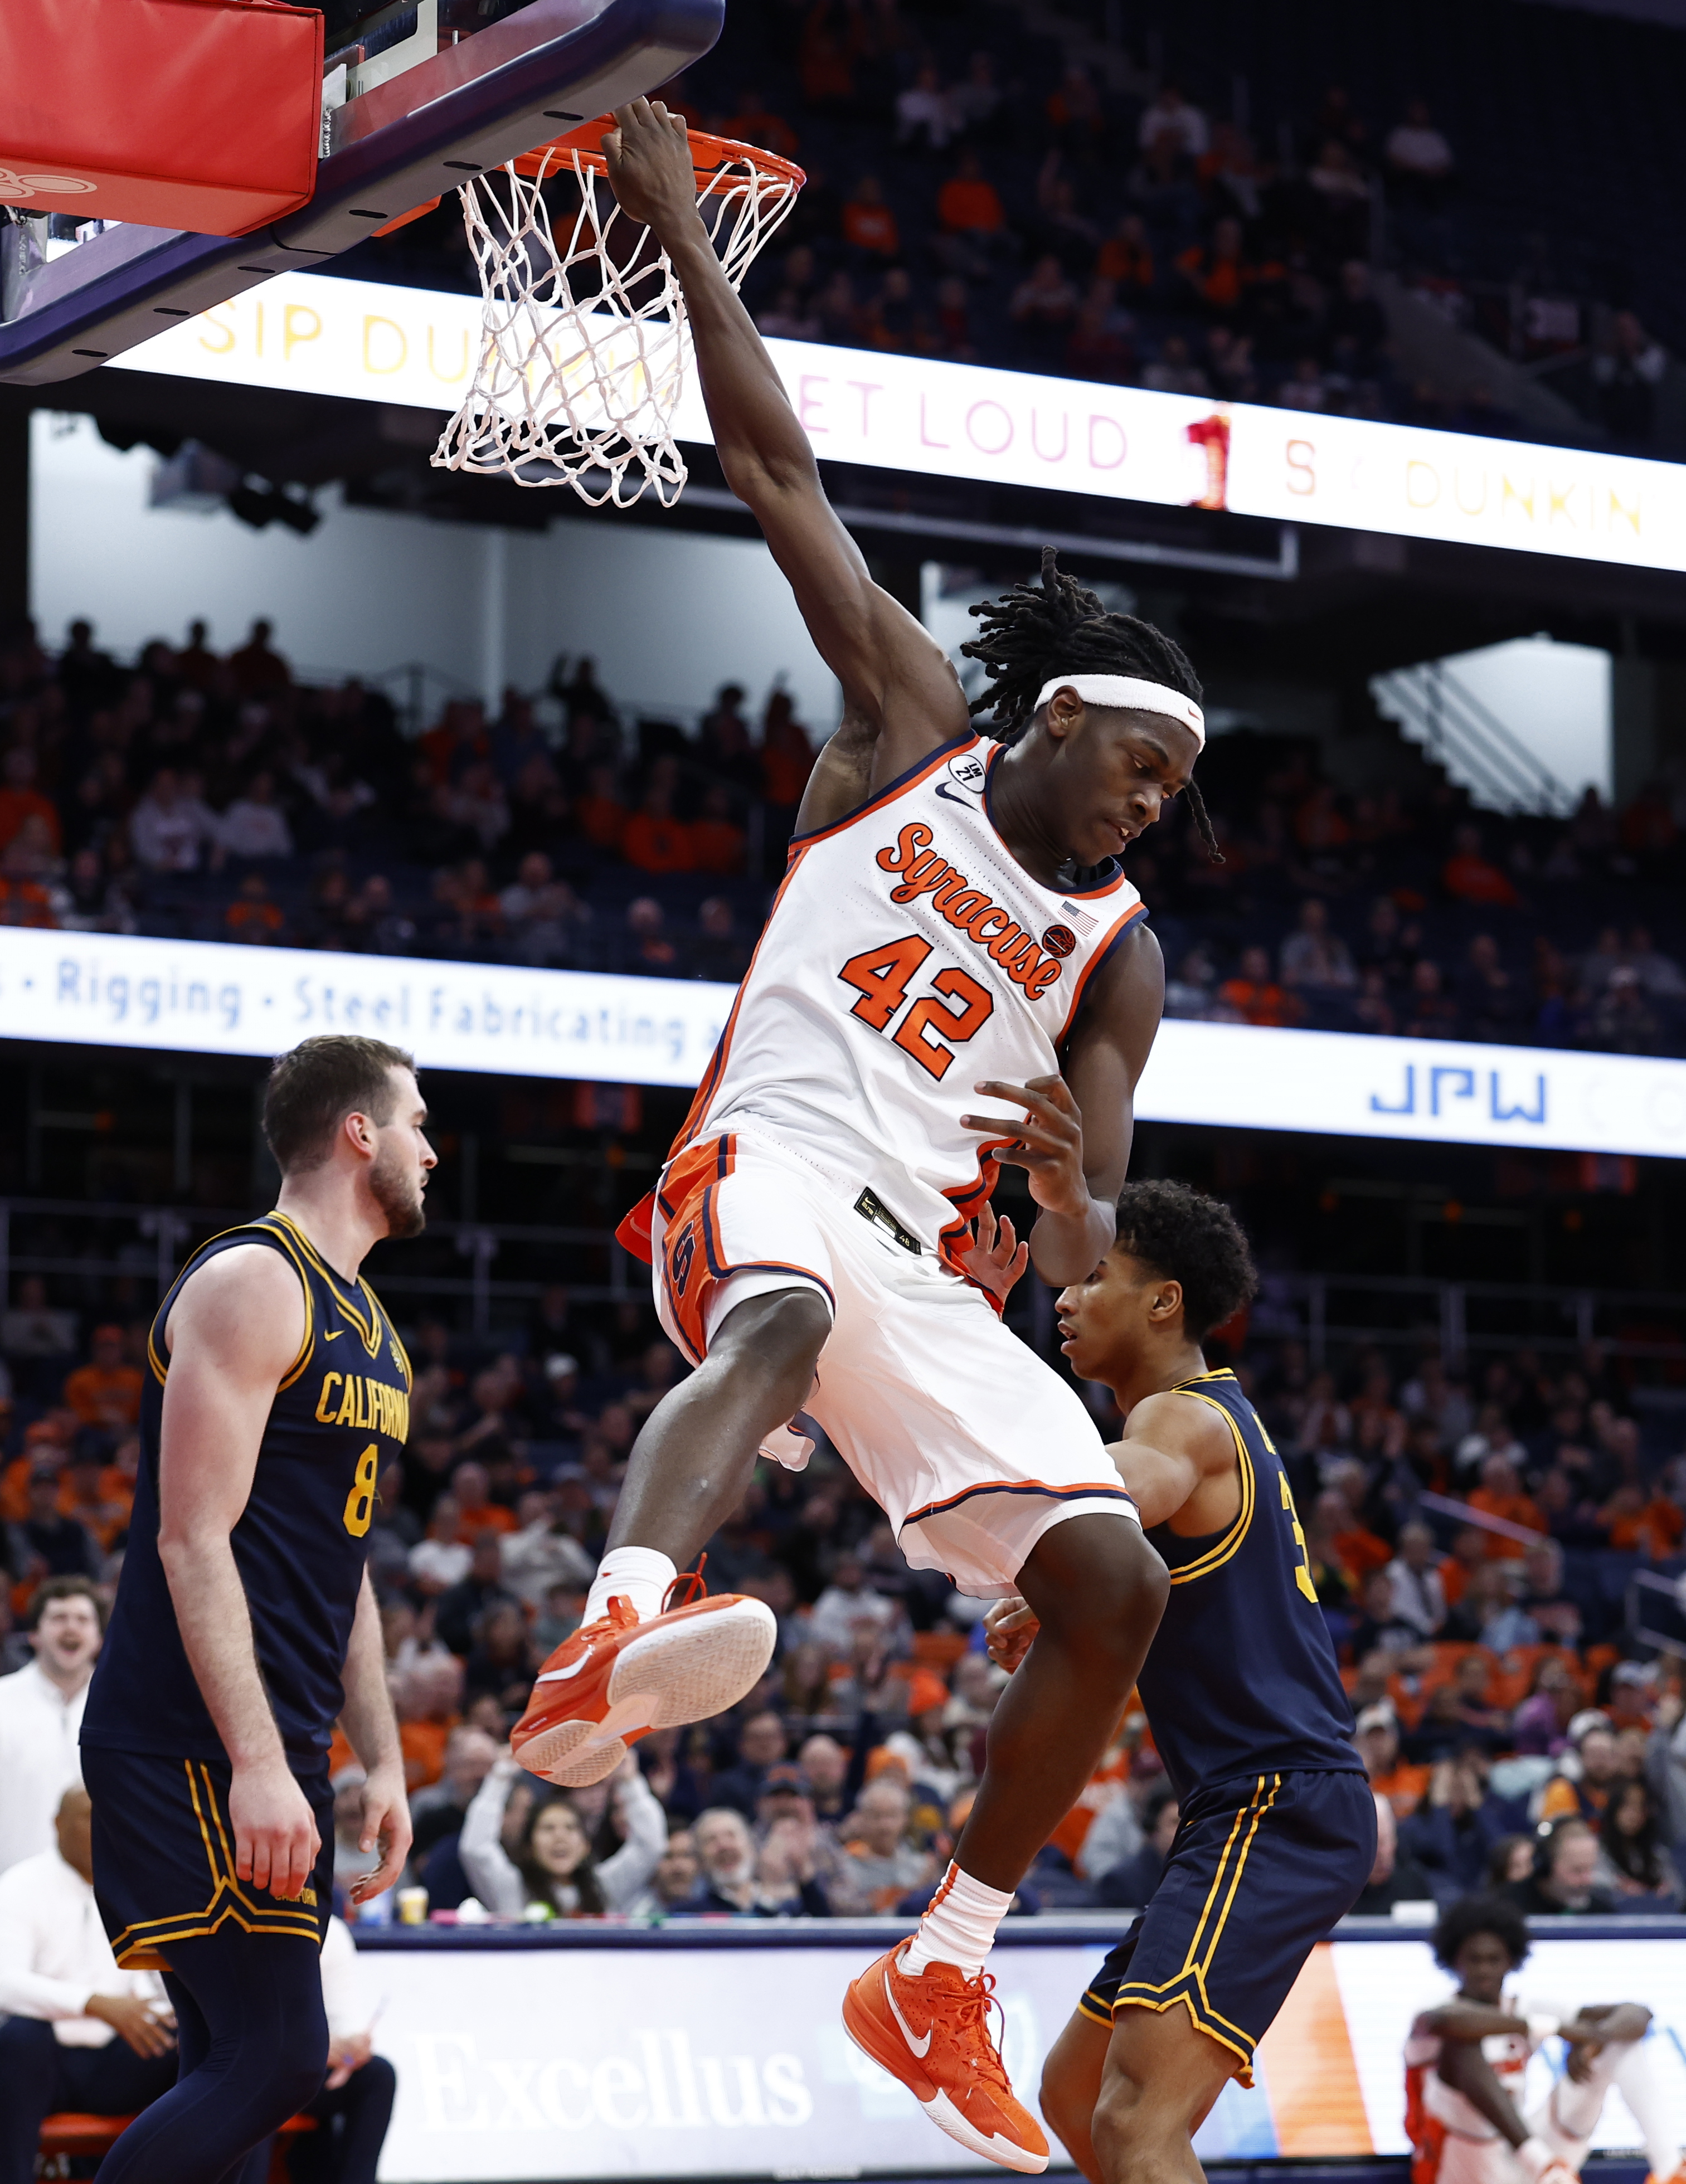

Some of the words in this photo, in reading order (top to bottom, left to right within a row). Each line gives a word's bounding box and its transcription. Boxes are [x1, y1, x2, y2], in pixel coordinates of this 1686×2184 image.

[197, 299, 322, 362] SIP
[799, 374, 885, 437] ET
[920, 392, 1128, 470] LOUD
[955, 767, 975, 781] 21
[969, 763, 983, 777] LM
[876, 822, 1062, 1000] Syracuse
[56, 953, 242, 1033] Rigging
[294, 974, 411, 1031] Steel
[429, 984, 687, 1064] Fabricating
[1368, 1063, 1548, 1125] JPW
[837, 934, 994, 1082] 42
[343, 1443, 378, 1538] 8
[407, 2027, 814, 2133] Excellus
